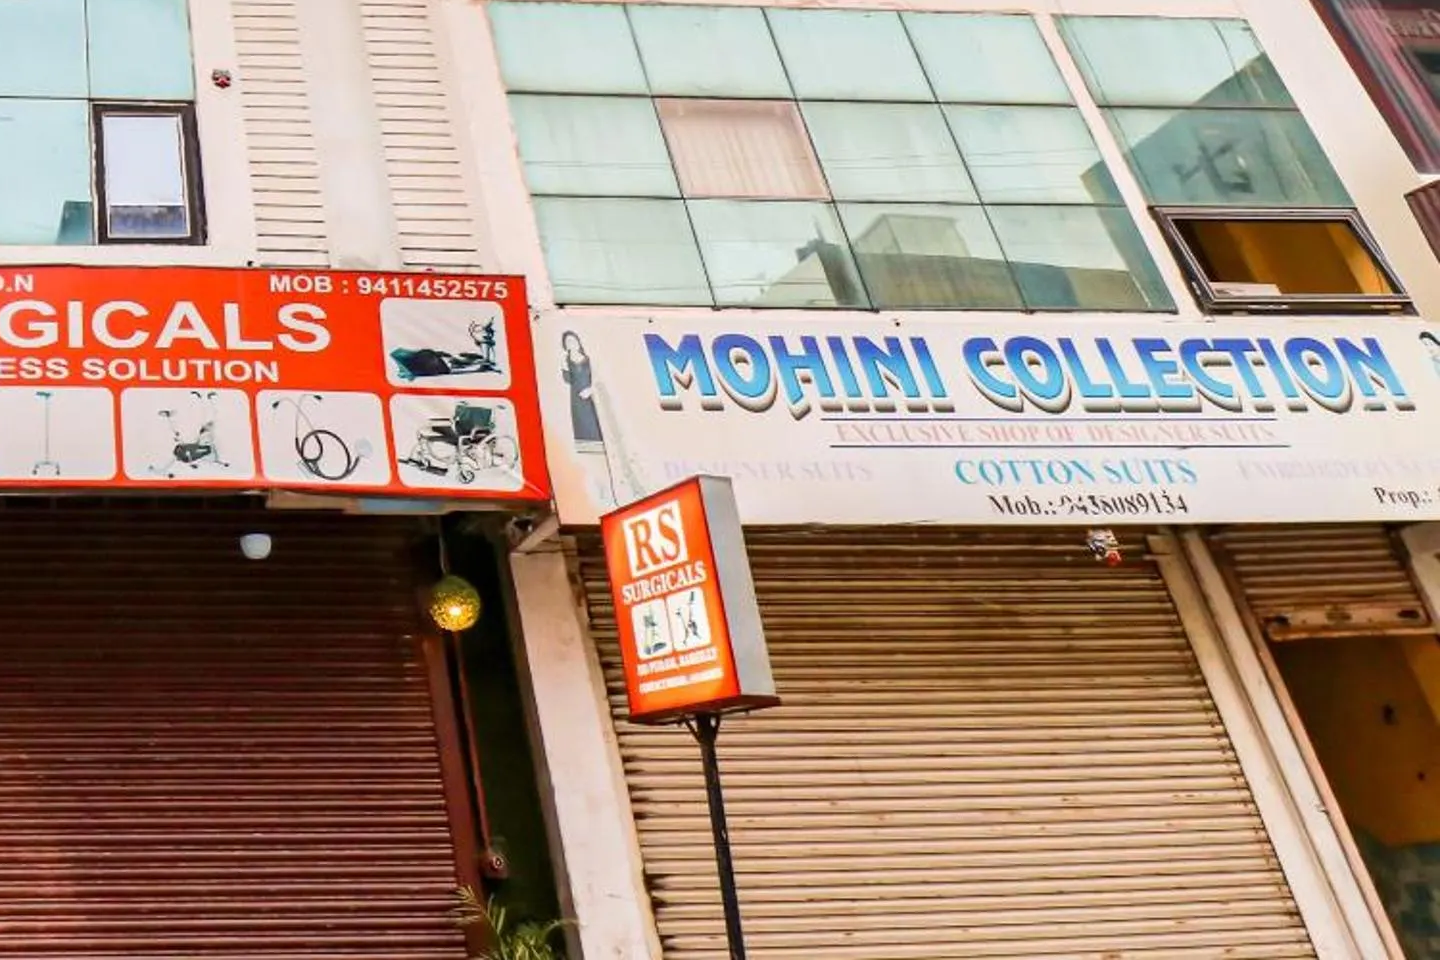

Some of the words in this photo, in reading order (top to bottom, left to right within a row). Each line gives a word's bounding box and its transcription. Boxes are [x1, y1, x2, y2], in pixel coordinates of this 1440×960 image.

[270, 275, 333, 293] MOB
[357, 277, 508, 299] 9411452575
[82, 357, 279, 383] SOLUTION
[643, 333, 954, 417] MOHINI
[962, 336, 1416, 413] COLLECTION
[837, 423, 977, 443] EXCLUSIVE
[981, 424, 1046, 442] SHOP
[1048, 424, 1078, 442] OF
[1087, 424, 1212, 443] DESIGNER
[1213, 424, 1277, 442] SUITS
[954, 458, 1098, 485] COTTON
[1102, 459, 1198, 486] SUITS
[628, 508, 681, 571] RS
[622, 561, 707, 604] SURGICALS
